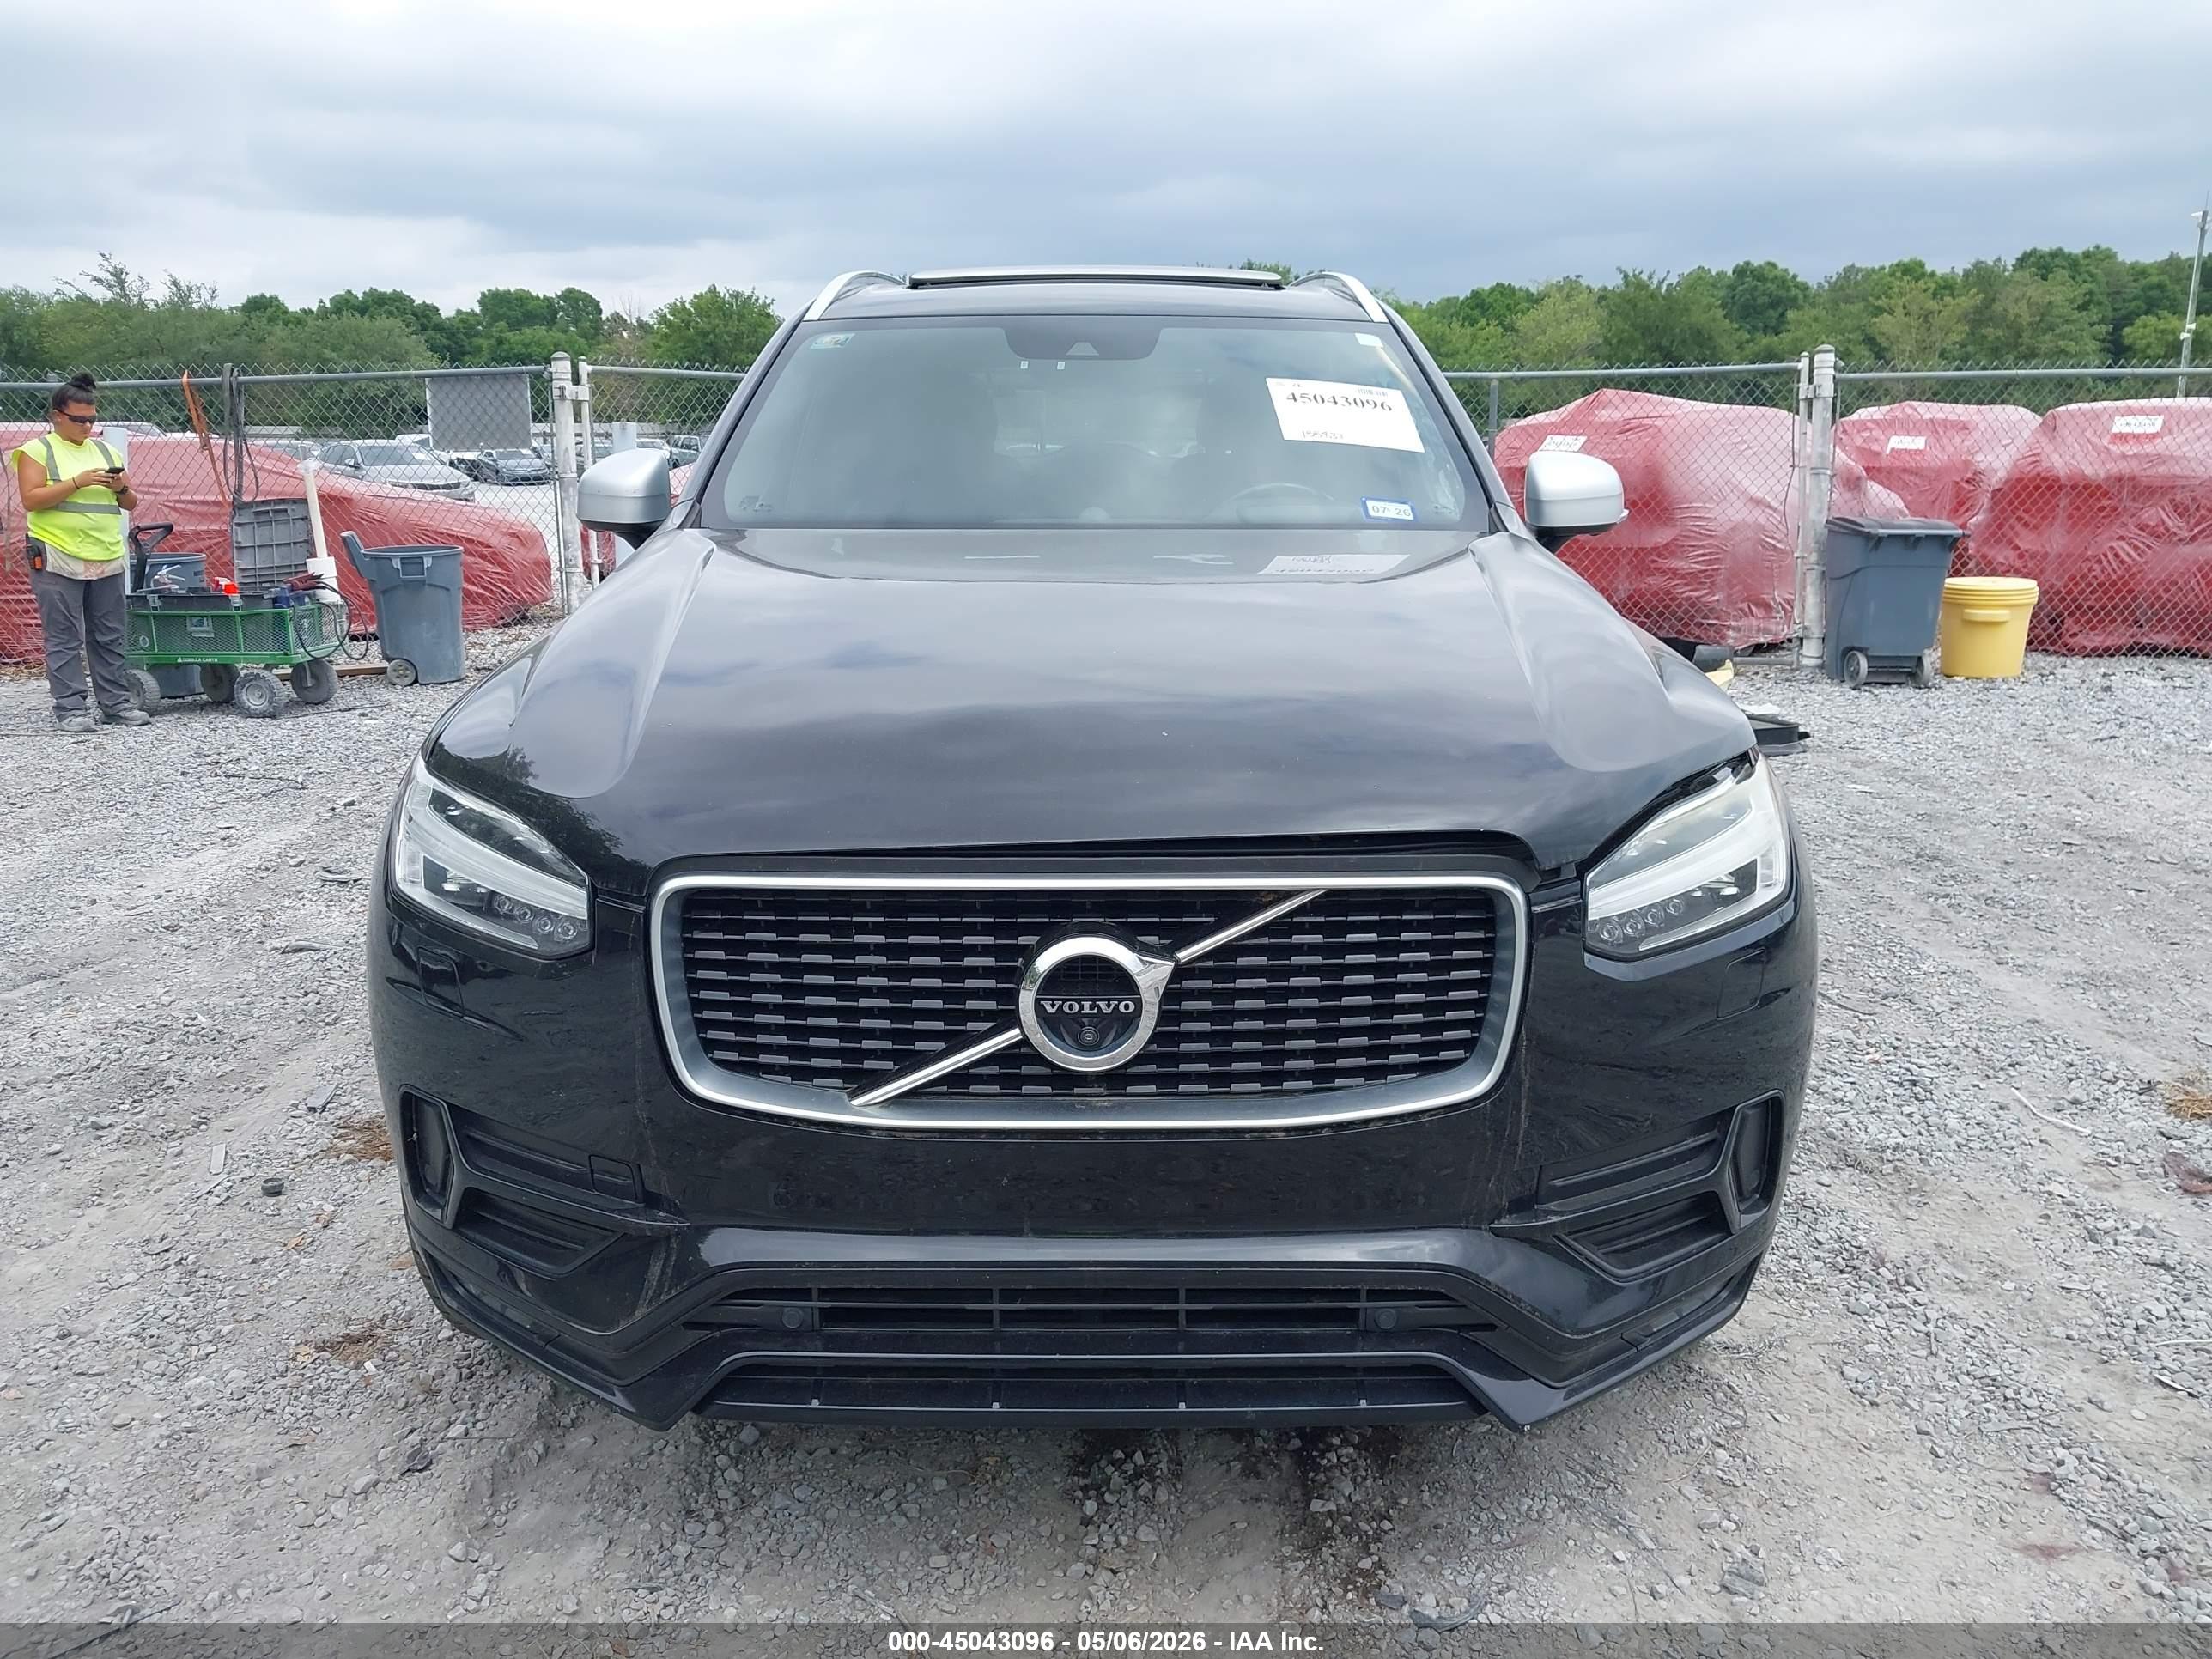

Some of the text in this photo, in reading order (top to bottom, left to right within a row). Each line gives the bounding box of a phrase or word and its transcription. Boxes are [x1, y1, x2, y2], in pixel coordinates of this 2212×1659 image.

[1286, 392, 1393, 412] 45043096
[1394, 507, 1411, 517] 26
[1040, 1000, 1136, 1013] VOLVO
